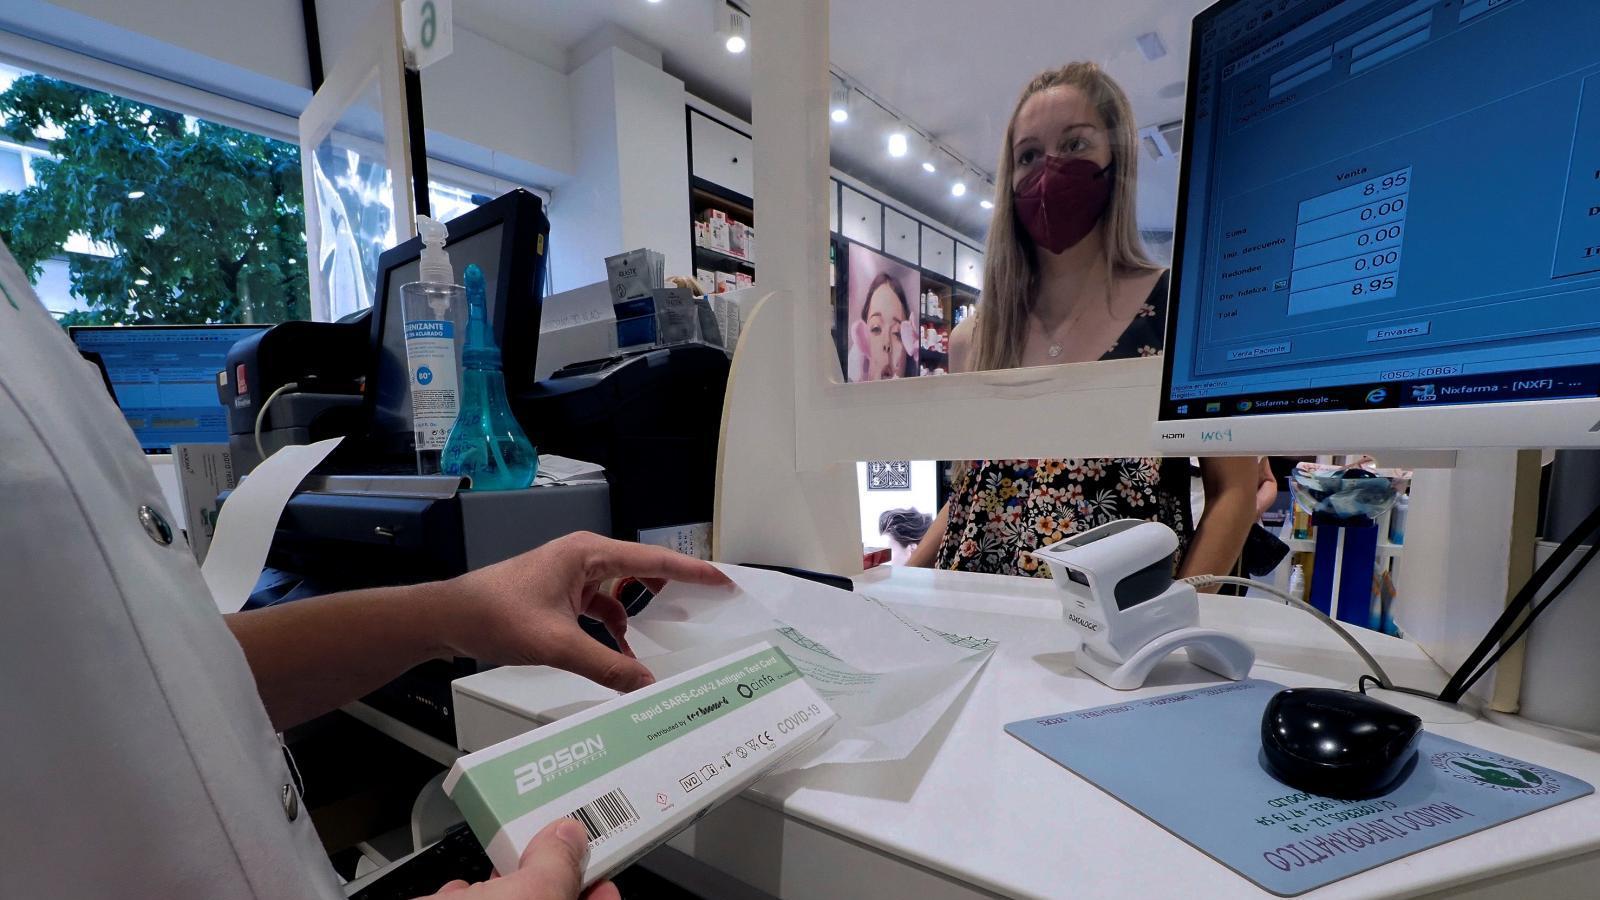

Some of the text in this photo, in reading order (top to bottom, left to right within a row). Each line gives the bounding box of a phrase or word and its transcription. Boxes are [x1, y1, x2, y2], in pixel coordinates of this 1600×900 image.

[1336, 166, 1368, 182] Venta
[1242, 237, 1286, 255] descuento
[1218, 309, 1238, 319] Total
[1376, 326, 1419, 338] Envases
[1441, 384, 1499, 395] Nixfarma
[1512, 379, 1553, 391] [NXF]
[1255, 399, 1289, 408] Sisfarma
[1297, 396, 1329, 406] Google
[1162, 432, 1185, 440] HDMI
[630, 705, 662, 724] Rapid
[662, 682, 716, 710] SARS-CoV-2
[717, 670, 746, 689] Antigen
[744, 661, 761, 674] Test
[760, 655, 777, 669] Card
[777, 703, 821, 735] COVID-19
[647, 722, 679, 742] Distributed
[678, 719, 687, 729] by
[514, 733, 605, 795] BOSON
[683, 776, 698, 789] IVD
[1292, 807, 1306, 820] 47
[1311, 801, 1334, 813] 983
[1255, 815, 1275, 827] 54
[1275, 811, 1292, 822] 79
[1316, 816, 1331, 827] 12
[1288, 823, 1307, 833] 14
[1263, 801, 1475, 872] MUNDO INFORMATICO
